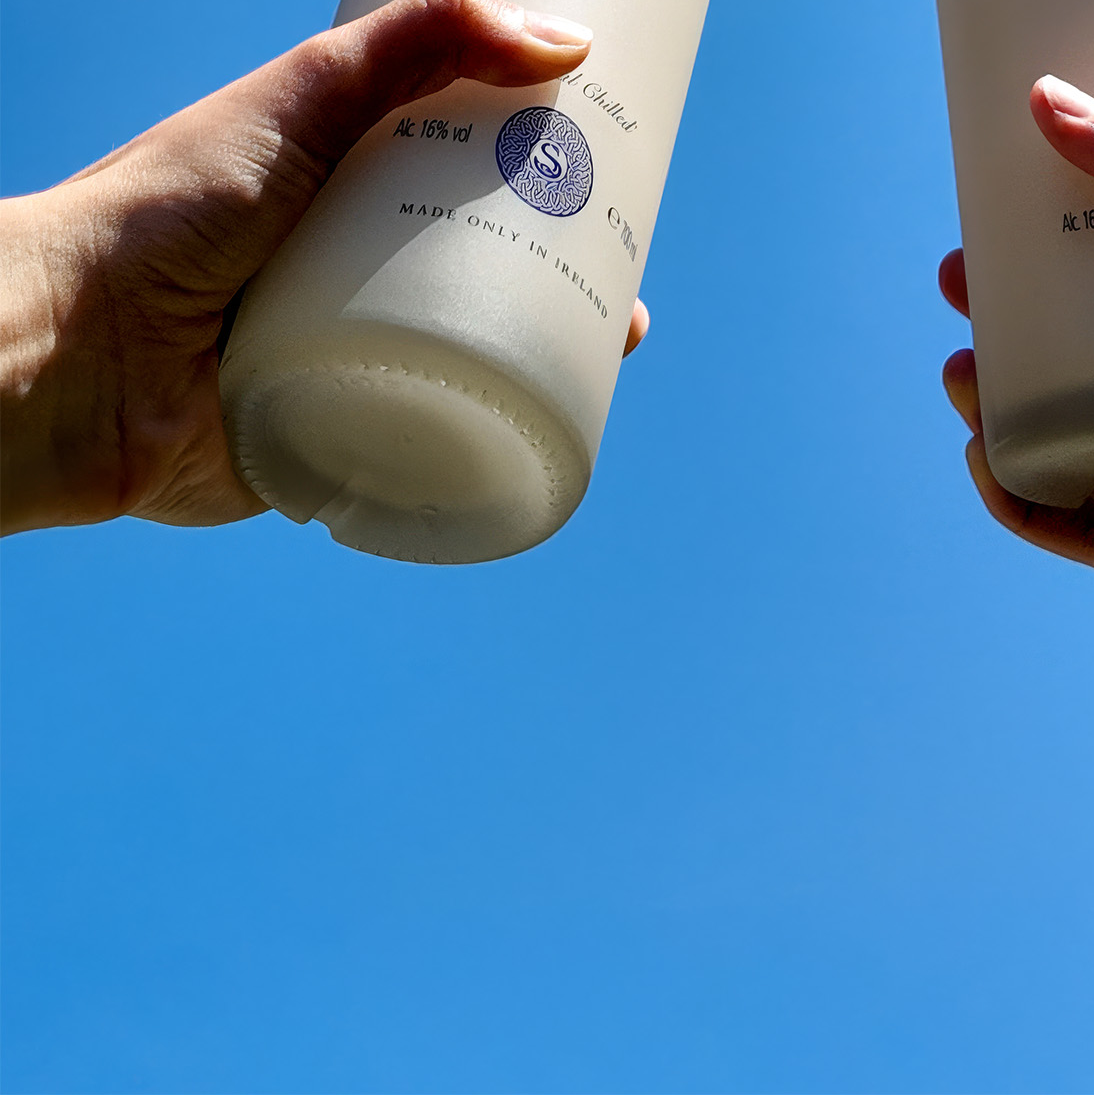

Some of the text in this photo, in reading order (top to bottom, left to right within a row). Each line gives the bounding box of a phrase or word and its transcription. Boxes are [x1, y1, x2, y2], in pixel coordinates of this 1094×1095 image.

[393, 117, 473, 144] Alc 16% vol
[1062, 212, 1081, 233] Alc
[399, 202, 609, 320] MADE ONLY IN IRELAND
